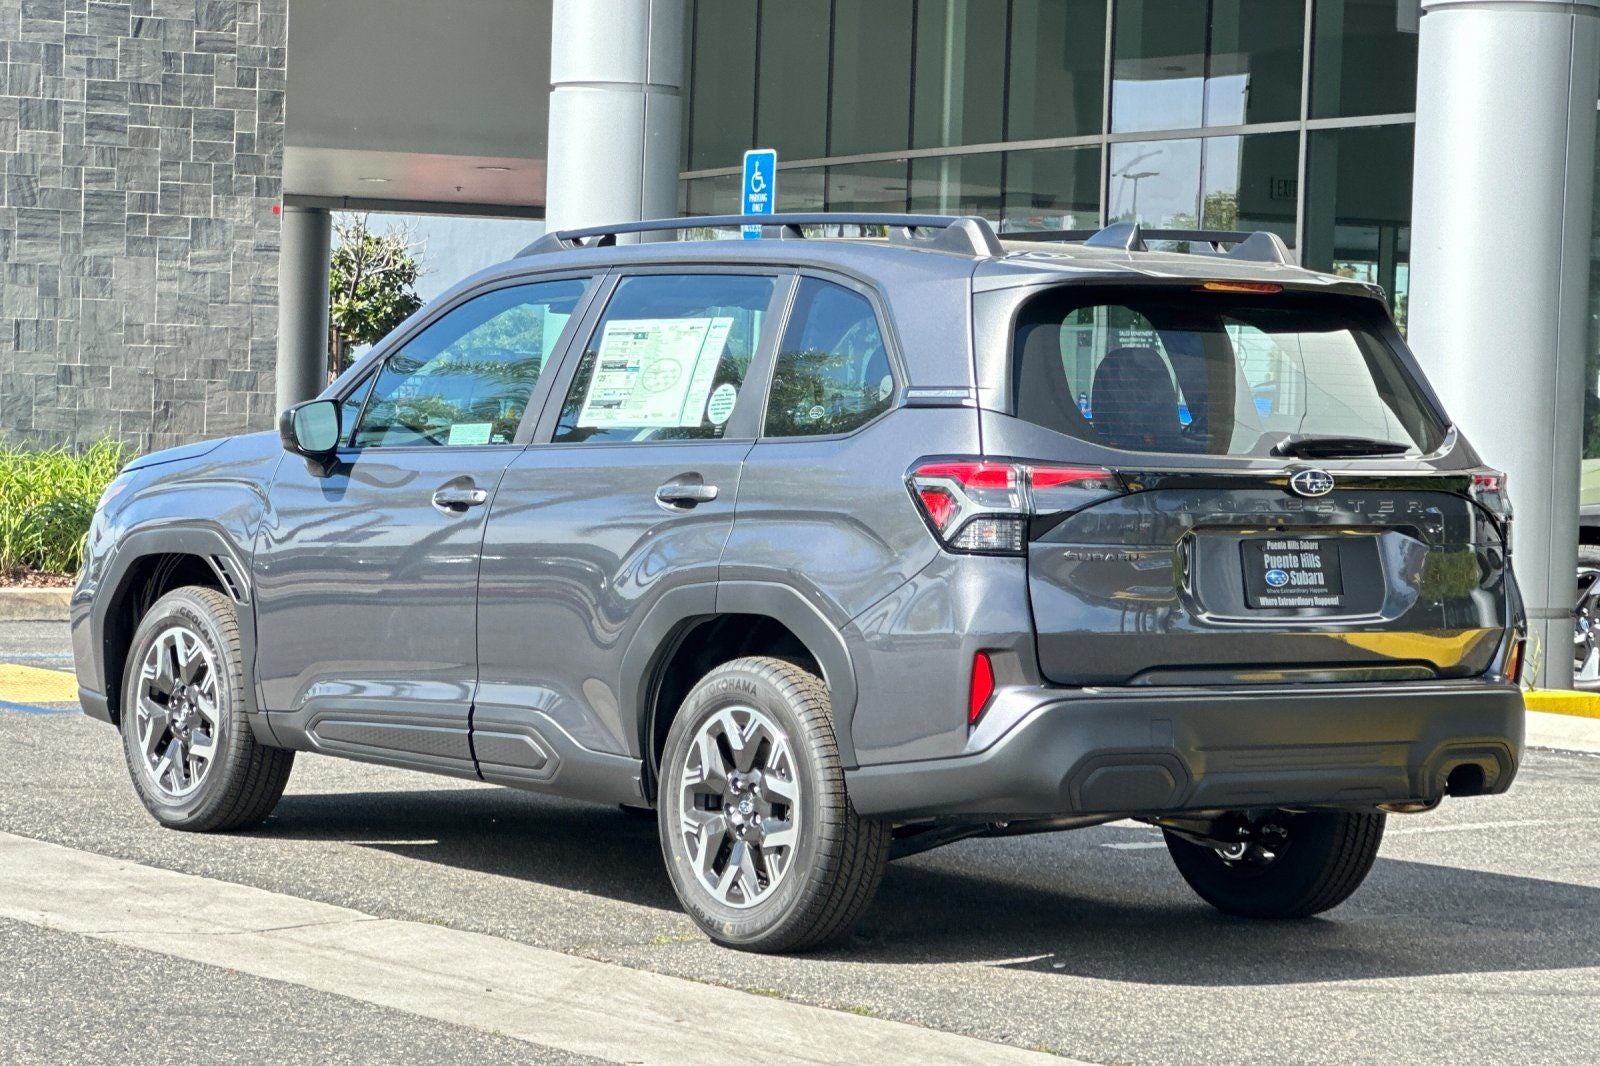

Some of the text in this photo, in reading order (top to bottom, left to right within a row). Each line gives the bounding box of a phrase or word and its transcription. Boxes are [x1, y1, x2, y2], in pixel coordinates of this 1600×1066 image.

[749, 193, 768, 202] PARKING
[751, 203, 764, 212] ONLY
[1267, 541, 1318, 550] Puente Hills Subaru
[1063, 550, 1140, 561] SUBARU
[1264, 553, 1321, 568] Puente Hills
[1290, 571, 1324, 585] Subaru
[1260, 597, 1278, 605] Where
[1278, 597, 1314, 606] Extraordinary
